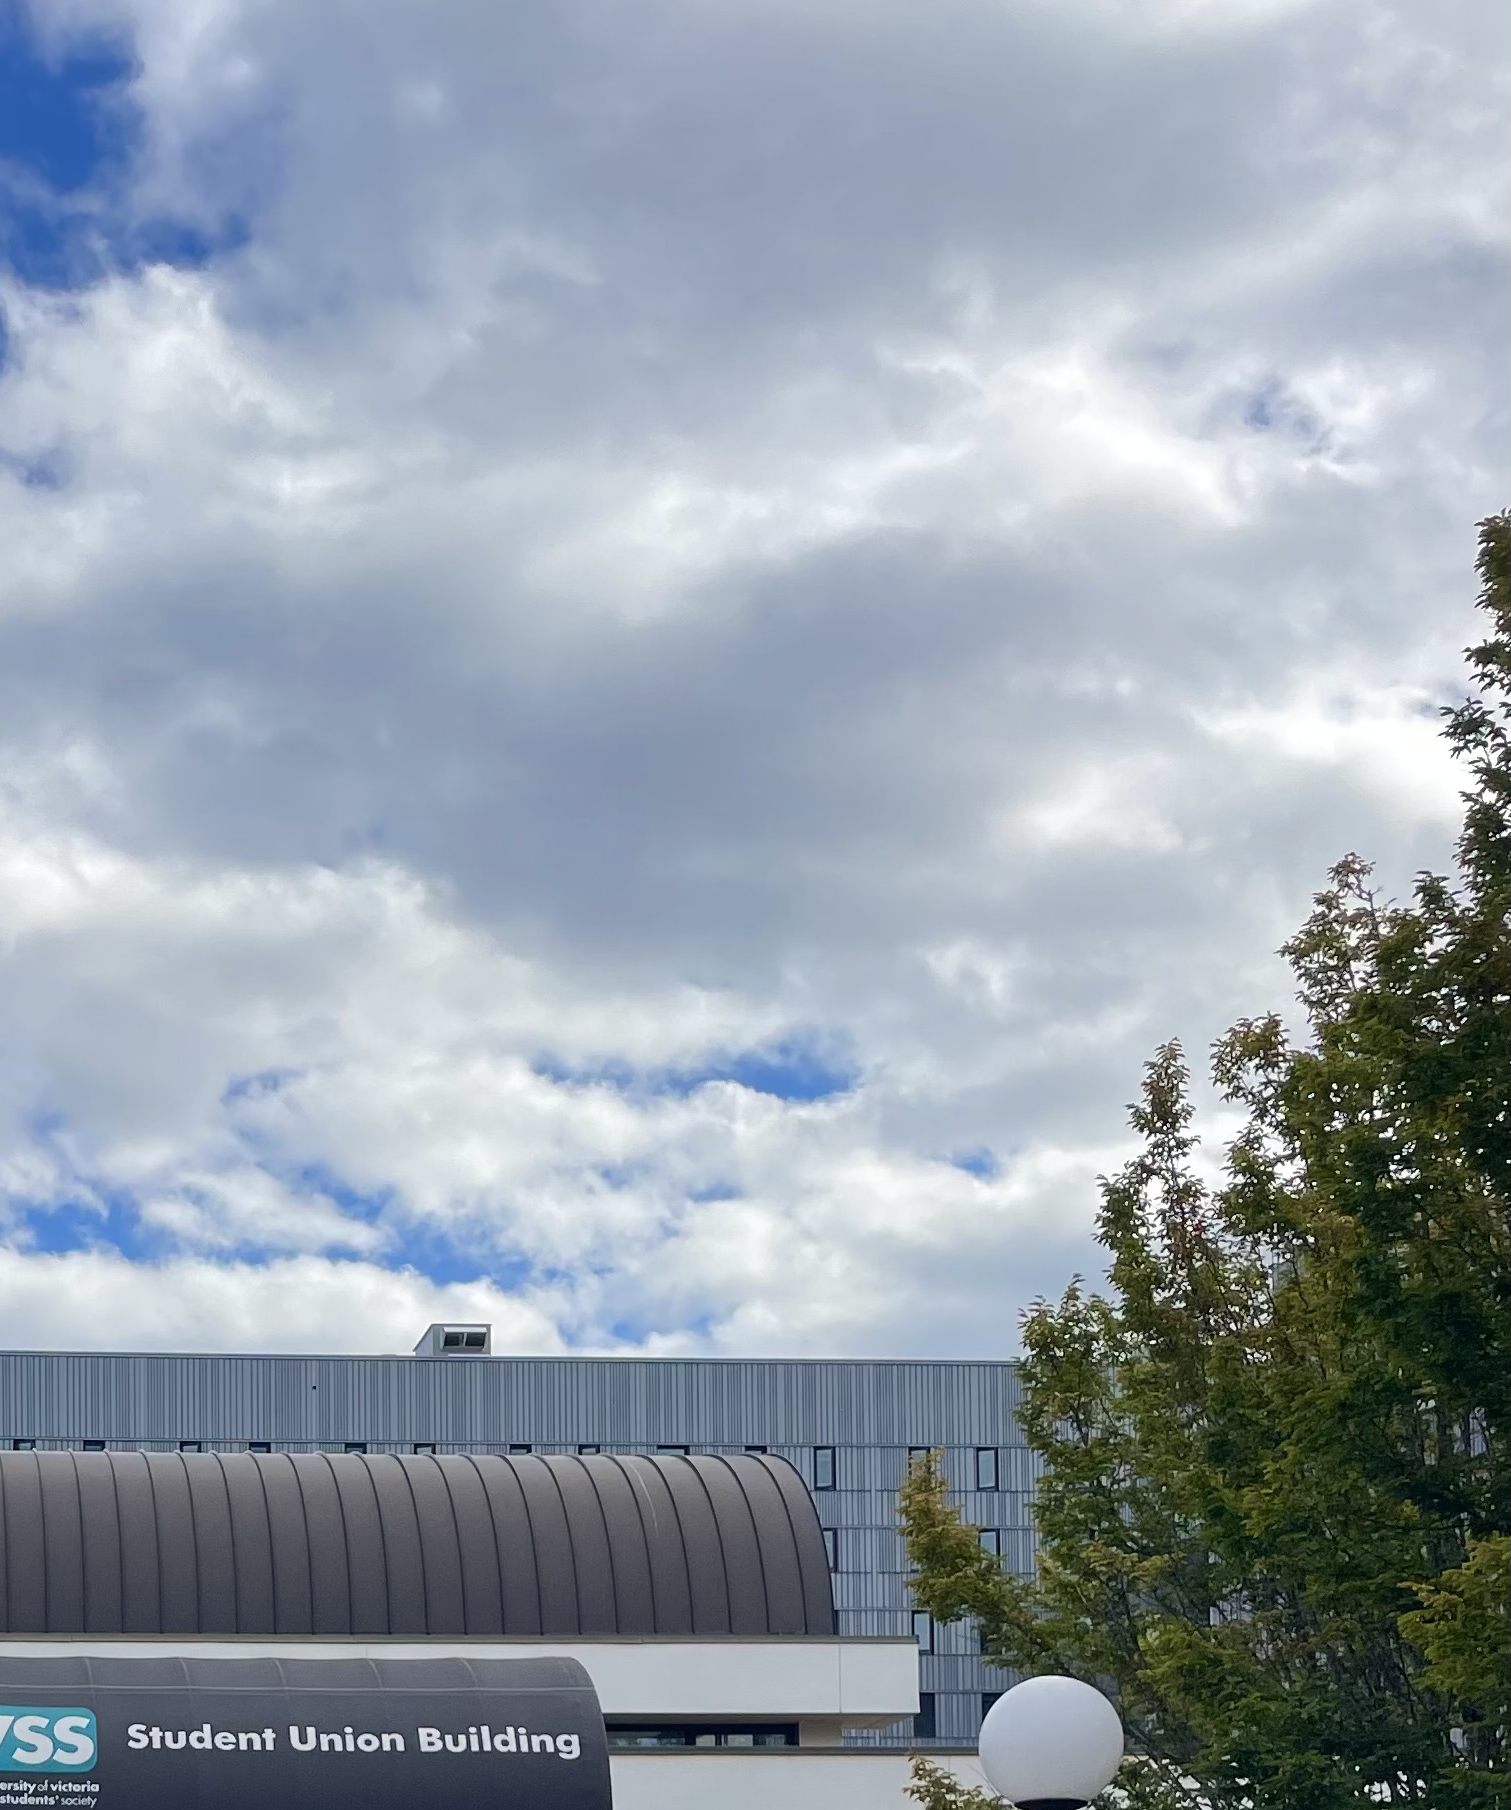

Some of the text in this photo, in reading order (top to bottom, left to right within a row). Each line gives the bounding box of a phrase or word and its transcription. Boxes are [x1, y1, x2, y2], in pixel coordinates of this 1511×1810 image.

[127, 1723, 581, 1760] Student Union Building
[37, 1780, 49, 1792] of
[50, 1780, 100, 1793] victoria
[60, 1794, 98, 1809] society
